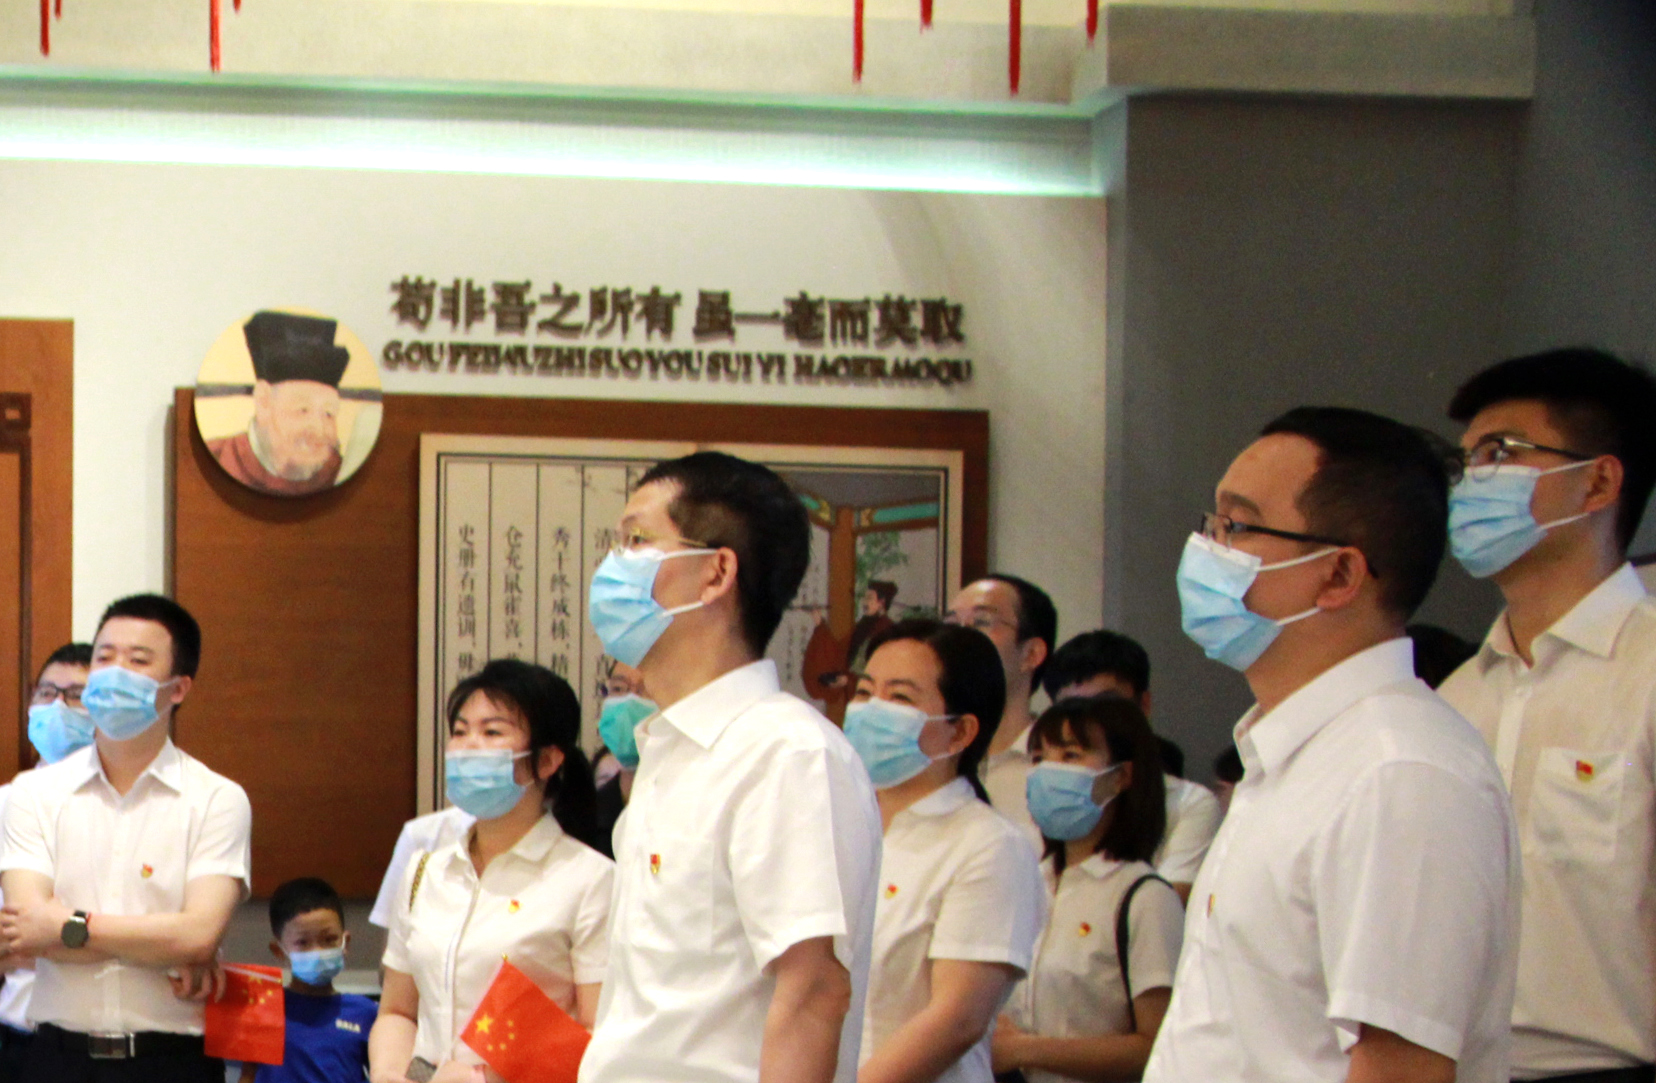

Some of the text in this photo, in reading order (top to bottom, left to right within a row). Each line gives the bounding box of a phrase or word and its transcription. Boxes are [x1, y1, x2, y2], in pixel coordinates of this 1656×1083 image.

[389, 274, 966, 349] 苟非吾之所有 虽一毫而莫取
